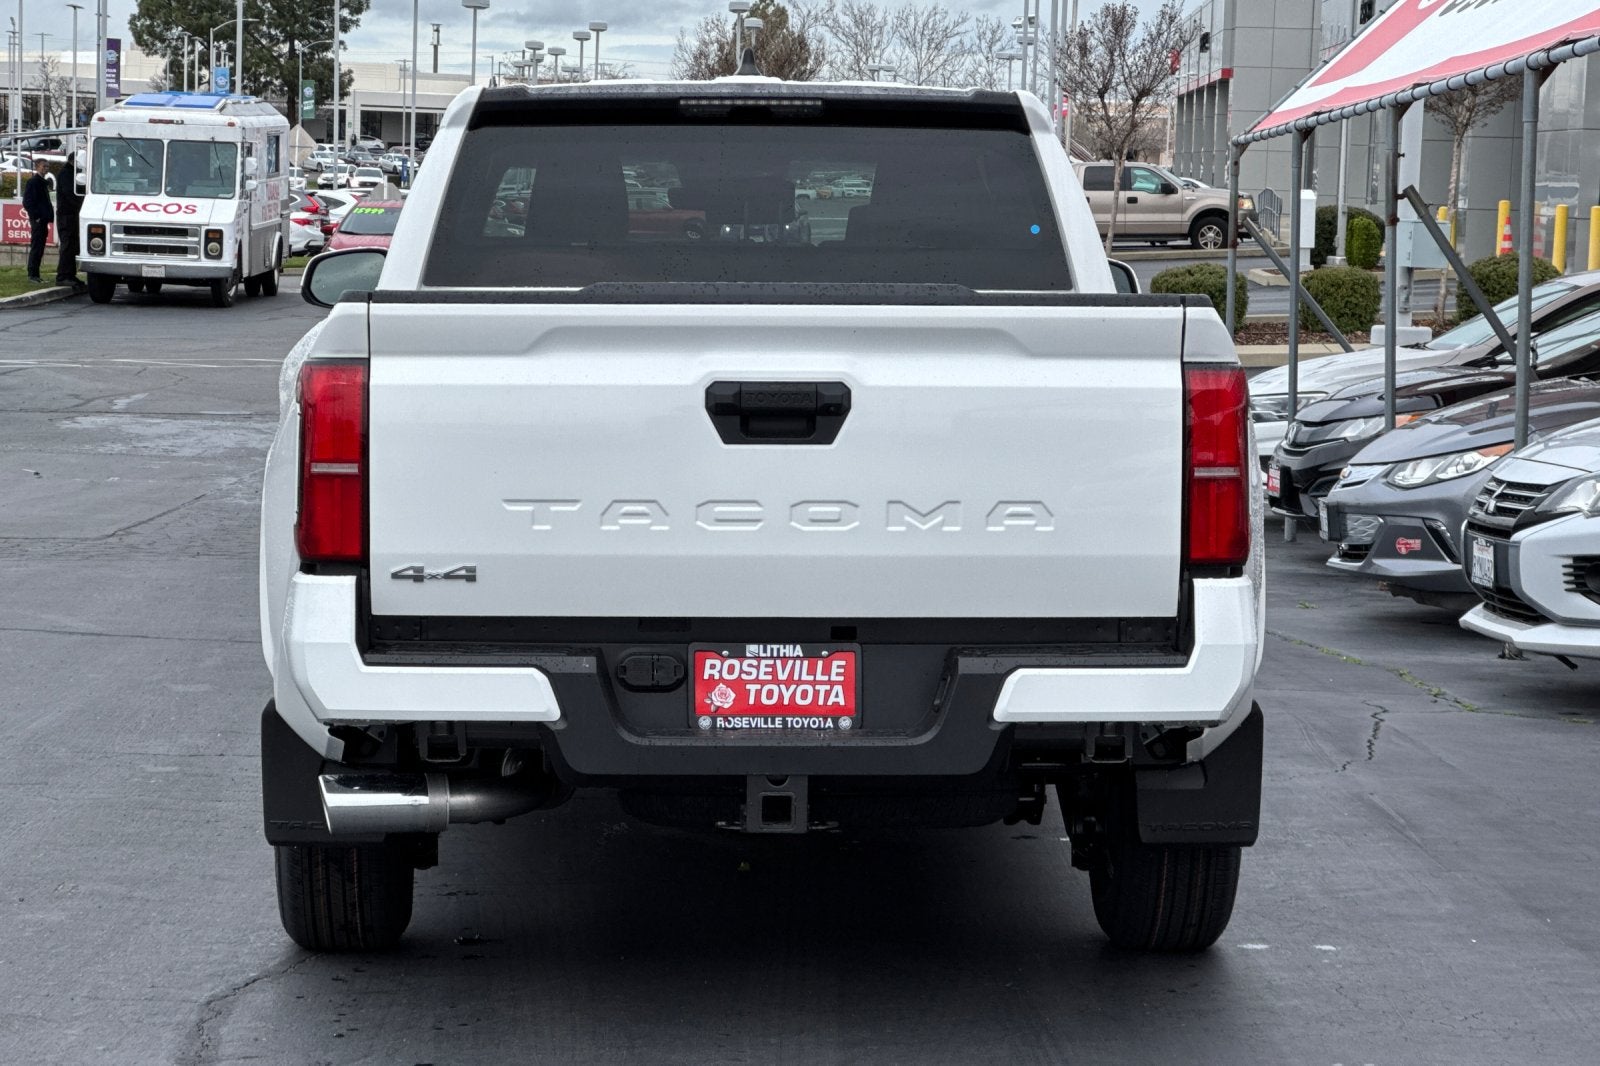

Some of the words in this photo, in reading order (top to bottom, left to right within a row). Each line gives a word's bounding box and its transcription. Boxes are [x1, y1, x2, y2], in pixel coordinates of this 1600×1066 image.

[113, 201, 198, 215] TACOS
[502, 499, 1055, 532] TACOMA
[390, 564, 477, 583] 4x4
[759, 644, 804, 657] LITHIA
[703, 658, 847, 682] ROSEVILLE
[745, 683, 846, 706] TOYOTA
[716, 717, 783, 729] ROSEVILLE
[785, 717, 834, 729] TOYOTA
